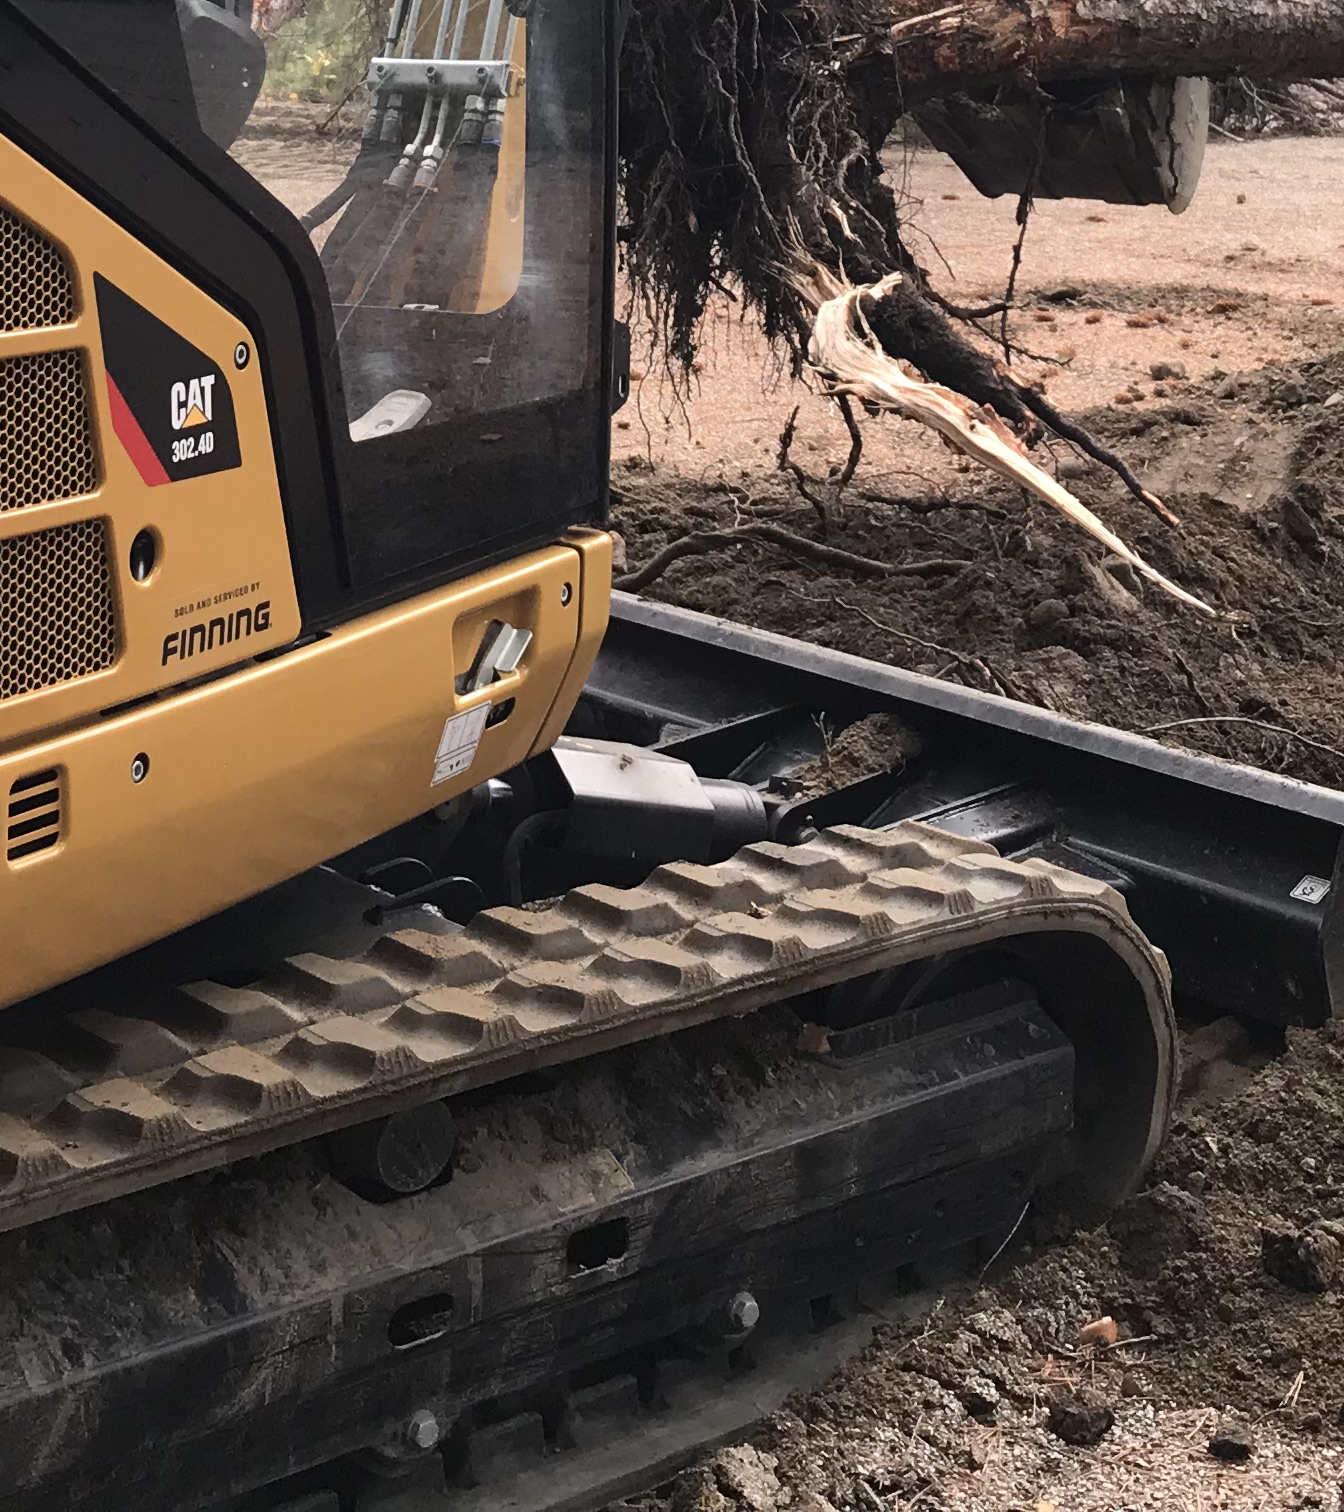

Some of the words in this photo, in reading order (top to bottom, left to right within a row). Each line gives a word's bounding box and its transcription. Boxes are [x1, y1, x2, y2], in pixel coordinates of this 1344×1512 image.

[170, 373, 216, 430] CAT
[171, 431, 214, 463] 302.4D
[161, 600, 271, 667] FINNING
